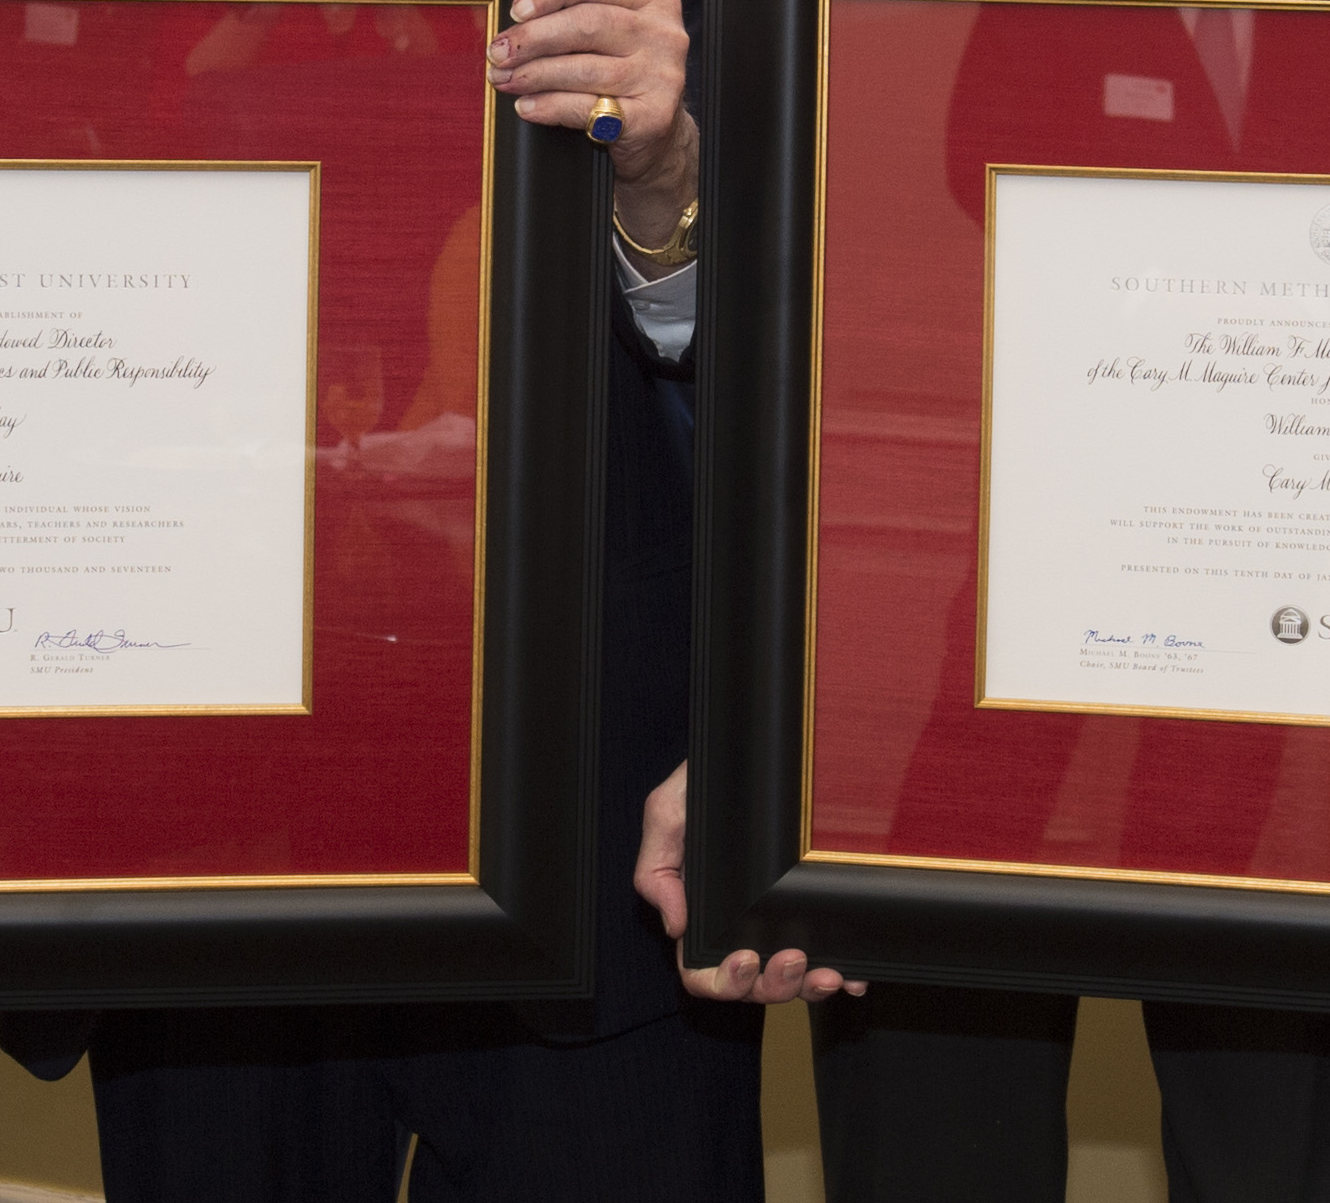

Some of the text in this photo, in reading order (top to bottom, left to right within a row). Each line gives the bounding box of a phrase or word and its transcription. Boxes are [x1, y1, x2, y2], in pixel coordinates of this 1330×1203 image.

[41, 274, 192, 289] UNIVERSITY
[1111, 277, 1247, 296] SOUTHERN
[70, 311, 84, 319] OF
[1217, 318, 1264, 326] PROUDLY
[47, 327, 116, 349] Director
[1184, 332, 1216, 355] The
[1220, 332, 1282, 358] William
[19, 362, 50, 379] and
[51, 357, 104, 380] Public
[105, 356, 216, 389] Responsibility
[1087, 359, 1104, 385] of
[1102, 357, 1125, 379] the
[1127, 356, 1168, 391] Cary
[1194, 361, 1260, 393] Maguire
[1263, 362, 1319, 388] Center
[1263, 464, 1312, 500] Cary
[1172, 507, 1238, 517] ENDOWMENT
[1110, 519, 1135, 527] WILL
[1139, 520, 1184, 529] SUPPORT
[1190, 523, 1209, 531] THE
[1214, 524, 1243, 532] WORK
[1249, 525, 1262, 533] OF
[1167, 536, 1178, 544] IN
[1184, 537, 1204, 545] THE
[1209, 538, 1252, 547] PURSUIT
[21, 566, 79, 574] THOUSAND
[1121, 564, 1180, 574] PRESENTED
[1205, 568, 1229, 576] THIS
[1234, 570, 1269, 578] TENTH
[1298, 572, 1312, 580] OF
